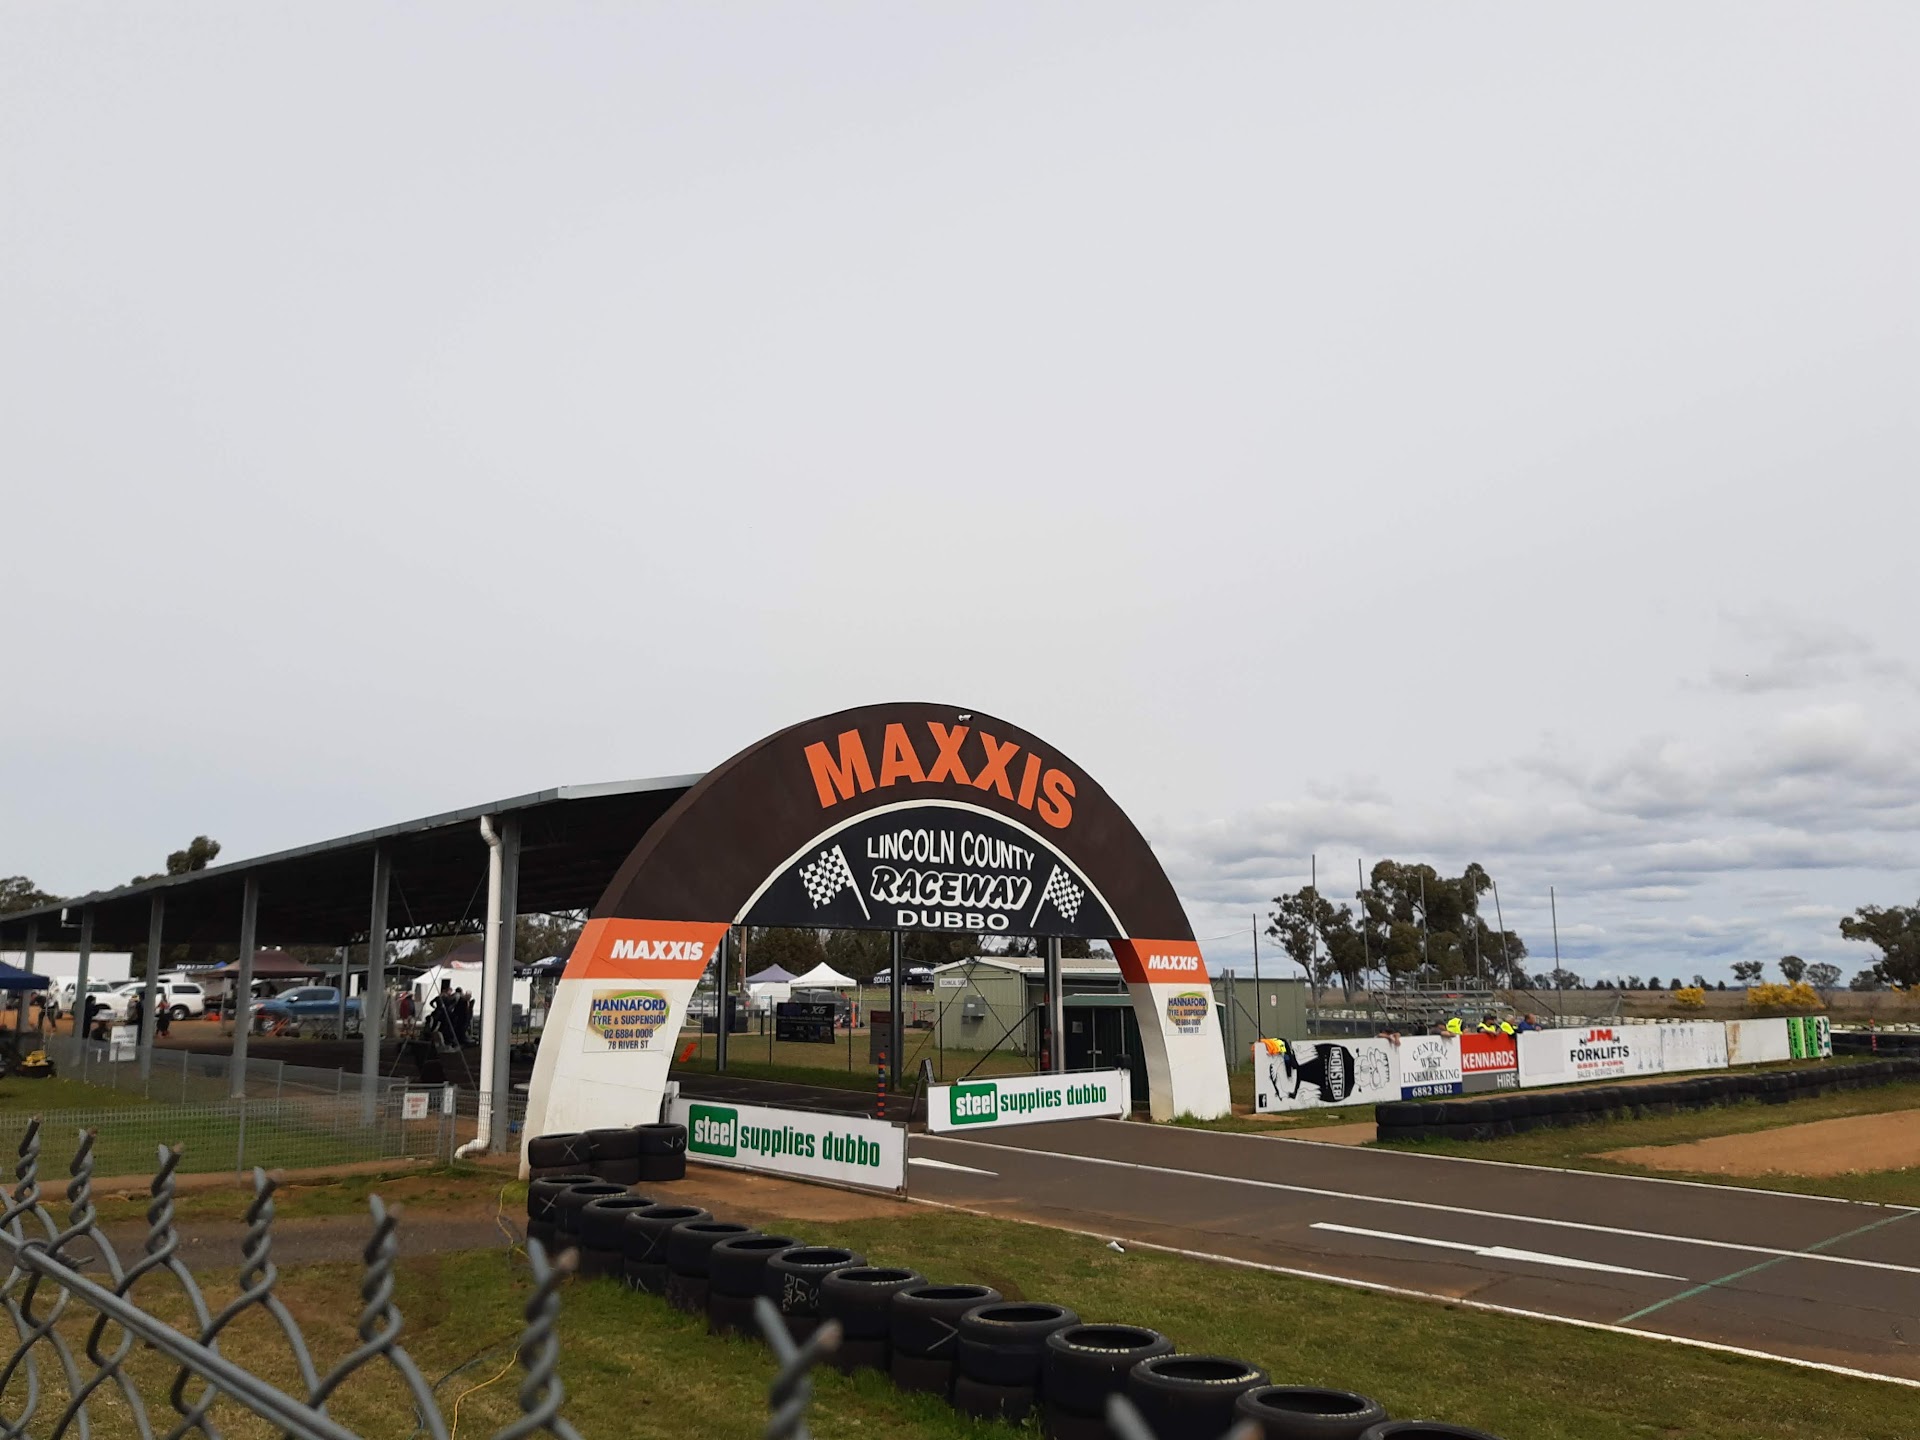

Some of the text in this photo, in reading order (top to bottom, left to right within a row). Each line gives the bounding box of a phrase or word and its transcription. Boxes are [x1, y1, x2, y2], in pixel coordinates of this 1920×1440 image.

[804, 721, 1076, 829] MAXXIS
[867, 829, 1035, 870] LINCOLN COUNTY
[870, 865, 1032, 910] RACEWAY
[897, 910, 1009, 930] DUBBO
[610, 939, 704, 961] MAXXIS
[1148, 955, 1198, 971] MAXXIS
[592, 999, 667, 1012] HANNAFORD
[1168, 998, 1207, 1007] HANNAFORD
[593, 1015, 666, 1026] TYRE & SUSPENSION
[604, 1030, 613, 1039] 02
[615, 1029, 634, 1039] 6884
[1587, 1029, 1613, 1042] JM
[608, 1040, 649, 1050] 78 RIVER ST
[1412, 1041, 1448, 1061] CENTRAL
[1462, 1051, 1515, 1070] KENNARDS
[1570, 1045, 1630, 1062] FORKLIFTS
[1420, 1056, 1442, 1069] WEST
[1331, 1048, 1344, 1099] MONSTER
[1403, 1069, 1460, 1083] LINEMARKING
[1497, 1073, 1516, 1088] HIRE
[1412, 1084, 1453, 1097] 6882 8812
[956, 1083, 1107, 1117] steel supplies dubbo
[694, 1115, 880, 1168] steel supplies dubbo
